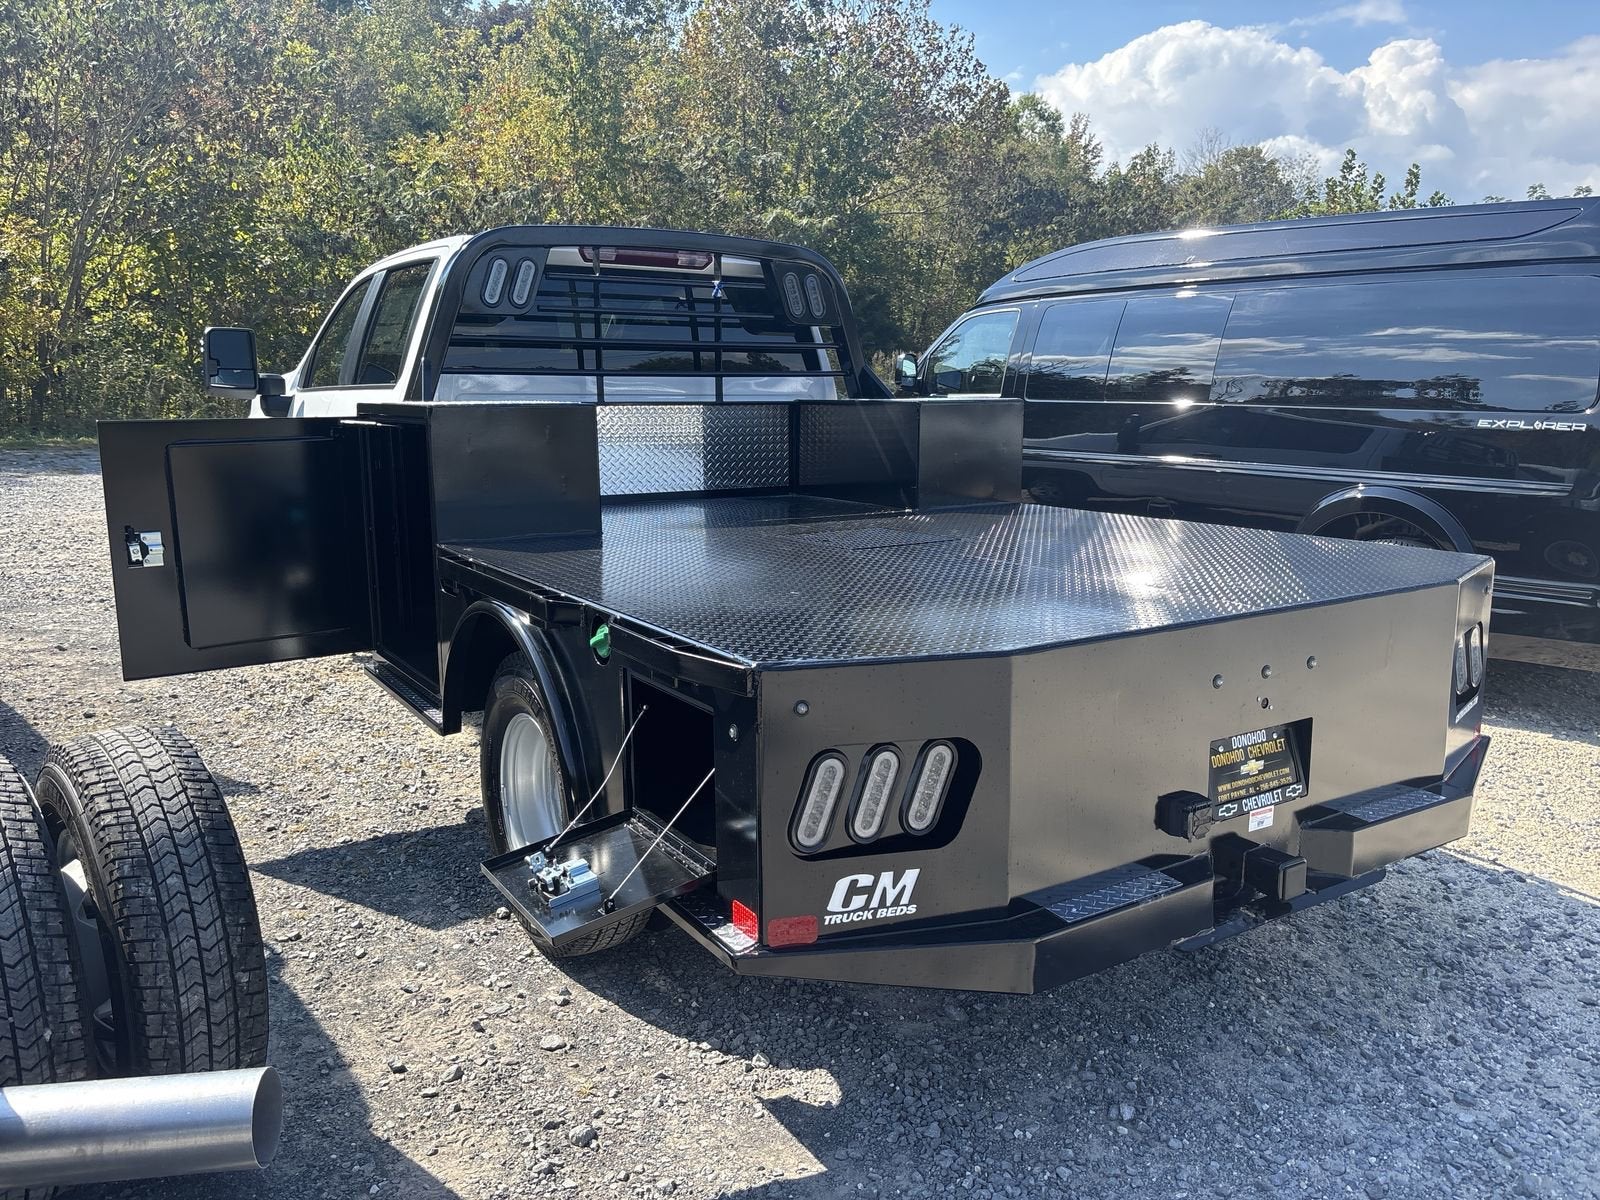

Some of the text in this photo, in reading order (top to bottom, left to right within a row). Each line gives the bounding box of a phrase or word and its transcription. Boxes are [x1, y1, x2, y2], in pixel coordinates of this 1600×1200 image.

[1477, 419, 1587, 431] EXPLORER
[1231, 729, 1267, 749] DONOHOO
[1211, 738, 1286, 768] DONOHOO CHEVROLET
[1217, 794, 1230, 803] FORT
[1242, 789, 1283, 811] CHEVROLET
[827, 868, 920, 912] CM
[824, 904, 917, 925] TRUCK BEDS
